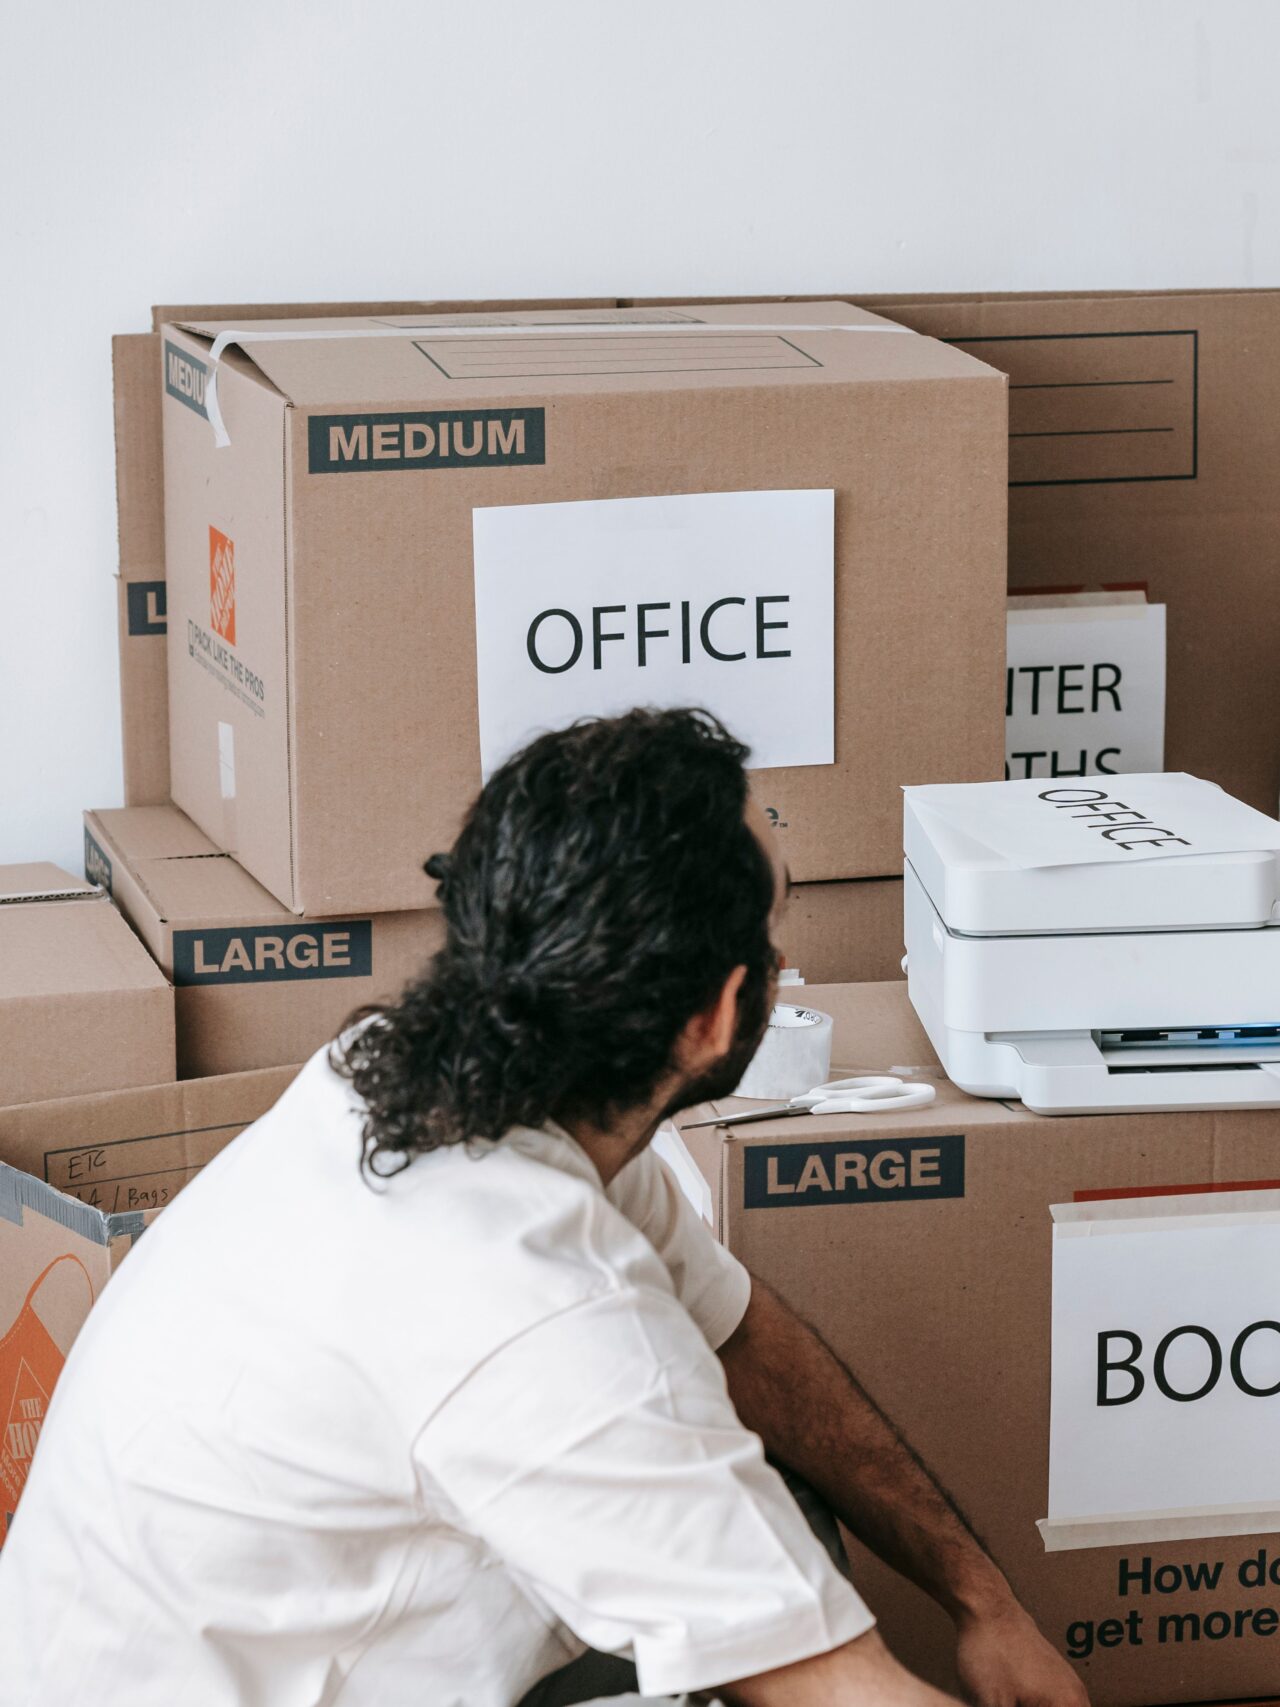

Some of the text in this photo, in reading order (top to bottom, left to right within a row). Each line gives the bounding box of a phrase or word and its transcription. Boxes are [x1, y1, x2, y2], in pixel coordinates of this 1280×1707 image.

[329, 419, 526, 461] MEDIUM
[527, 595, 791, 674] OFFICE
[229, 653, 243, 684] THE
[244, 667, 265, 702] PROS
[1038, 789, 1192, 850] OFFICE
[194, 932, 351, 974] LARGE
[68, 1150, 107, 1179] ETC
[767, 1149, 941, 1194] LARGE
[128, 1188, 169, 1209] Bags
[19, 1398, 43, 1419] THE
[1118, 1557, 1224, 1597] How
[1066, 1610, 1143, 1659] get
[1158, 1607, 1280, 1643] more
